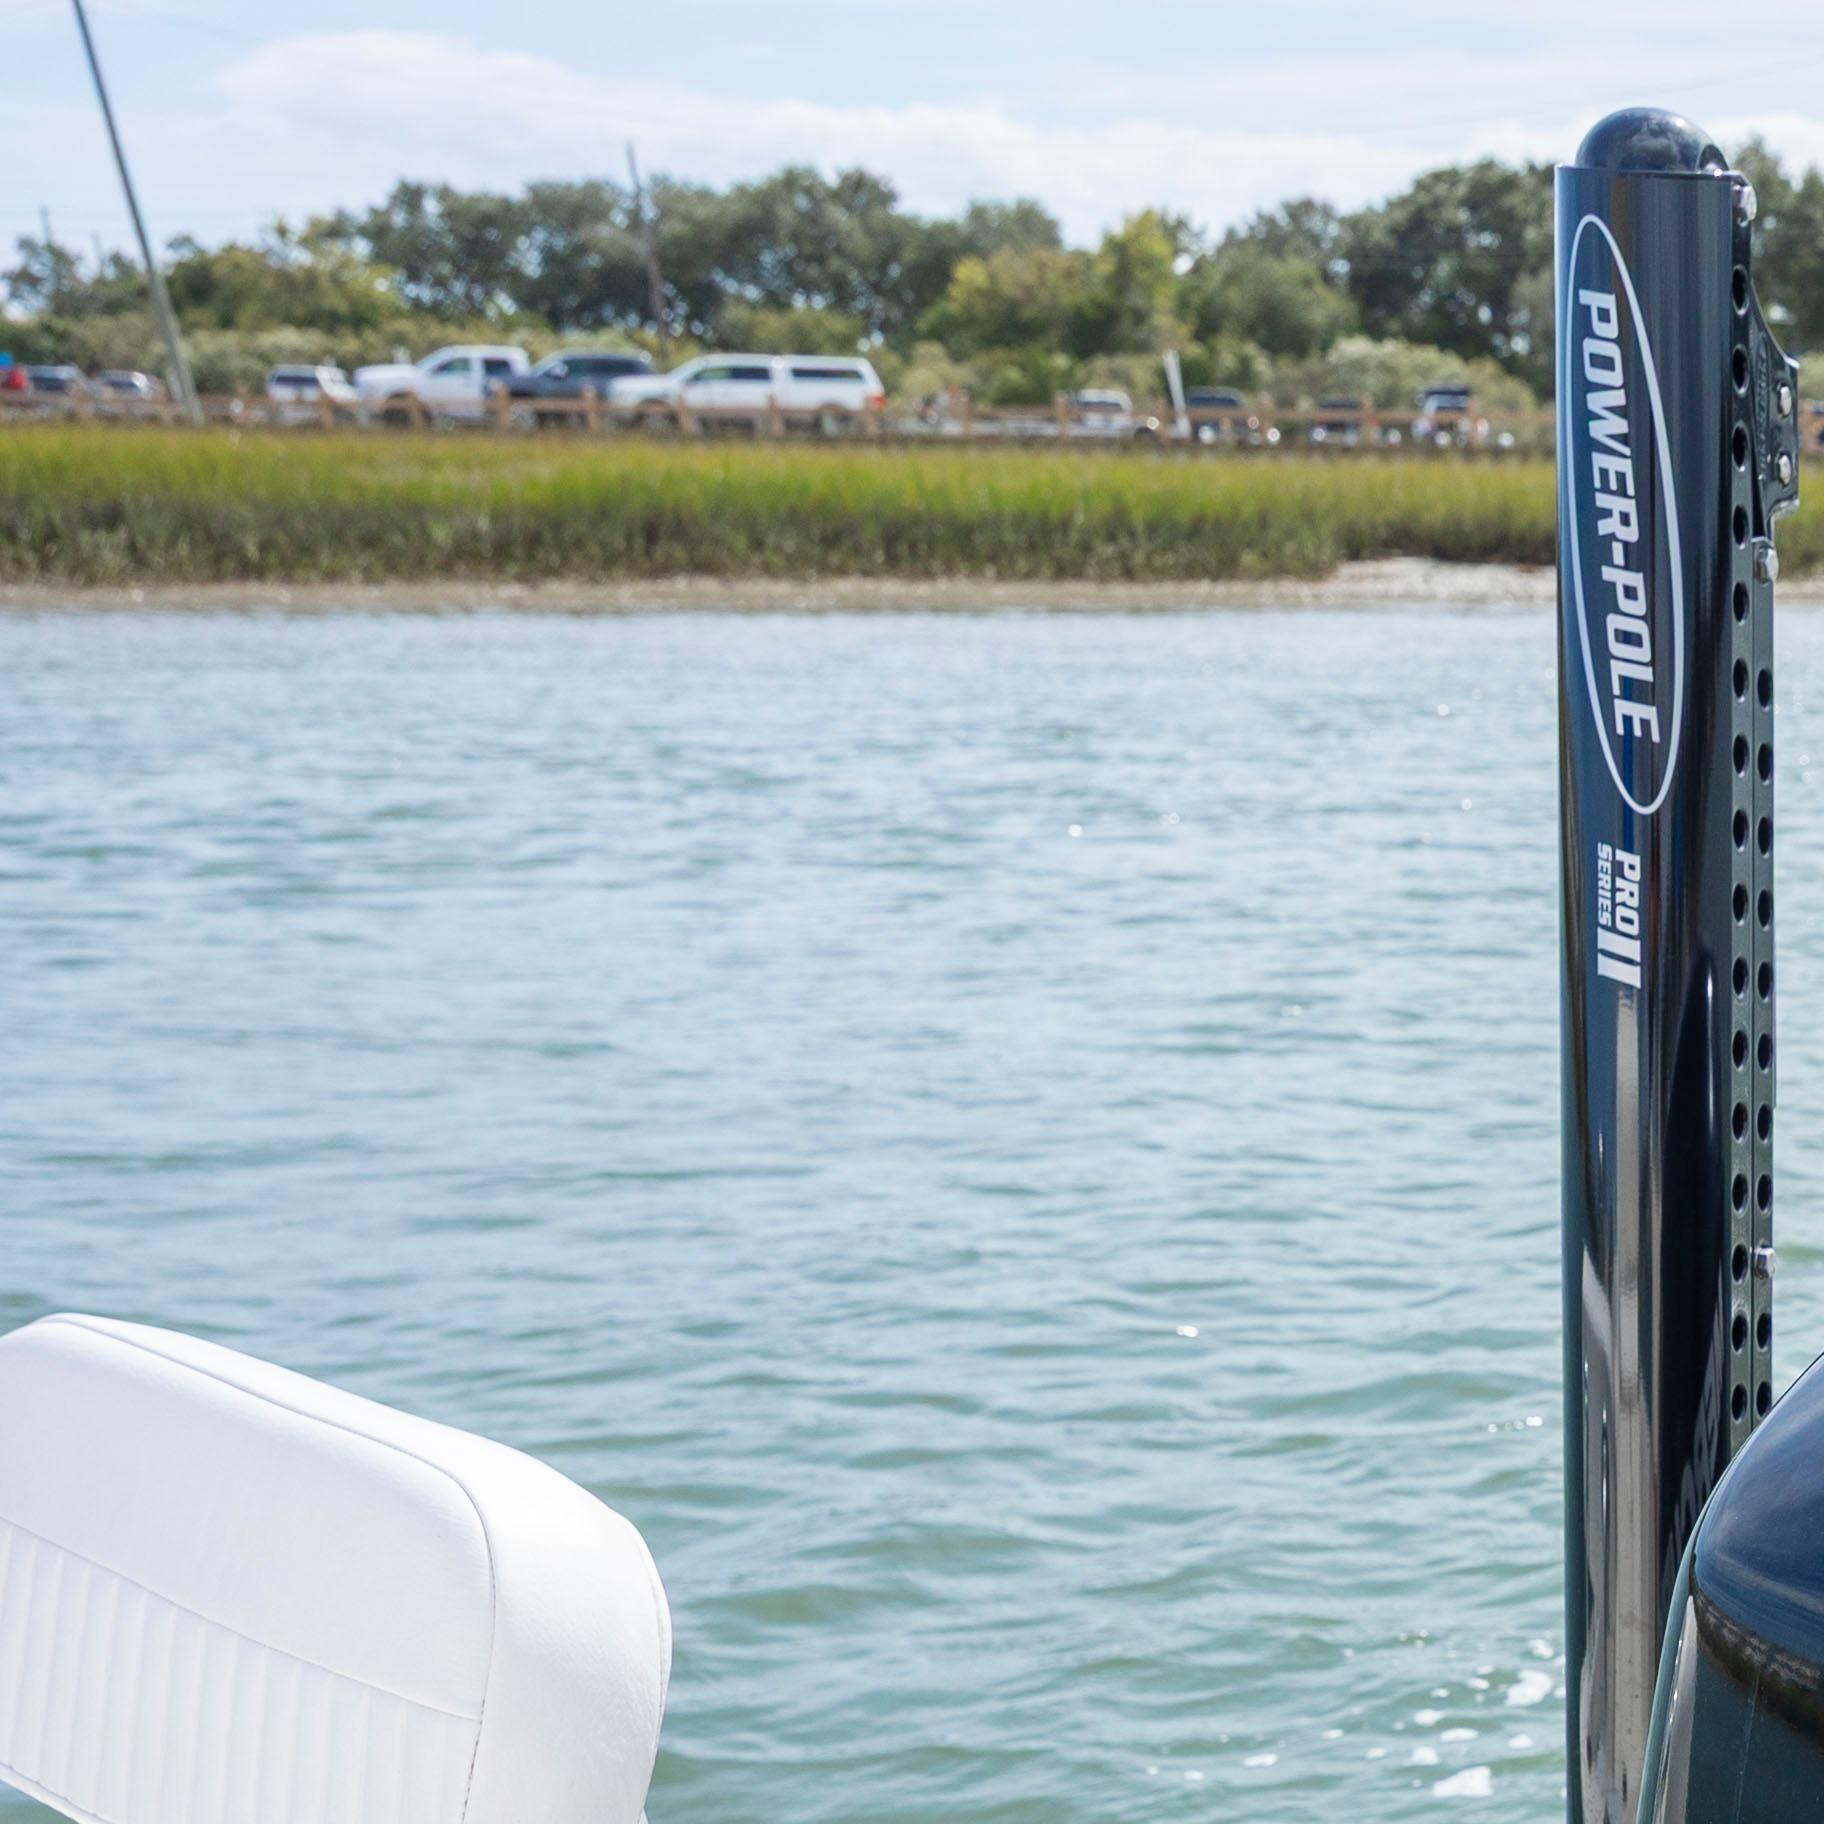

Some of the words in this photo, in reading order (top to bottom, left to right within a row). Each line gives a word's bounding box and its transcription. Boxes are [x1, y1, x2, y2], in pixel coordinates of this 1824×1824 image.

[1578, 288, 1660, 743] POWER-POLE
[1597, 842, 1612, 927] SERIES
[1615, 848, 1641, 940] PRO
